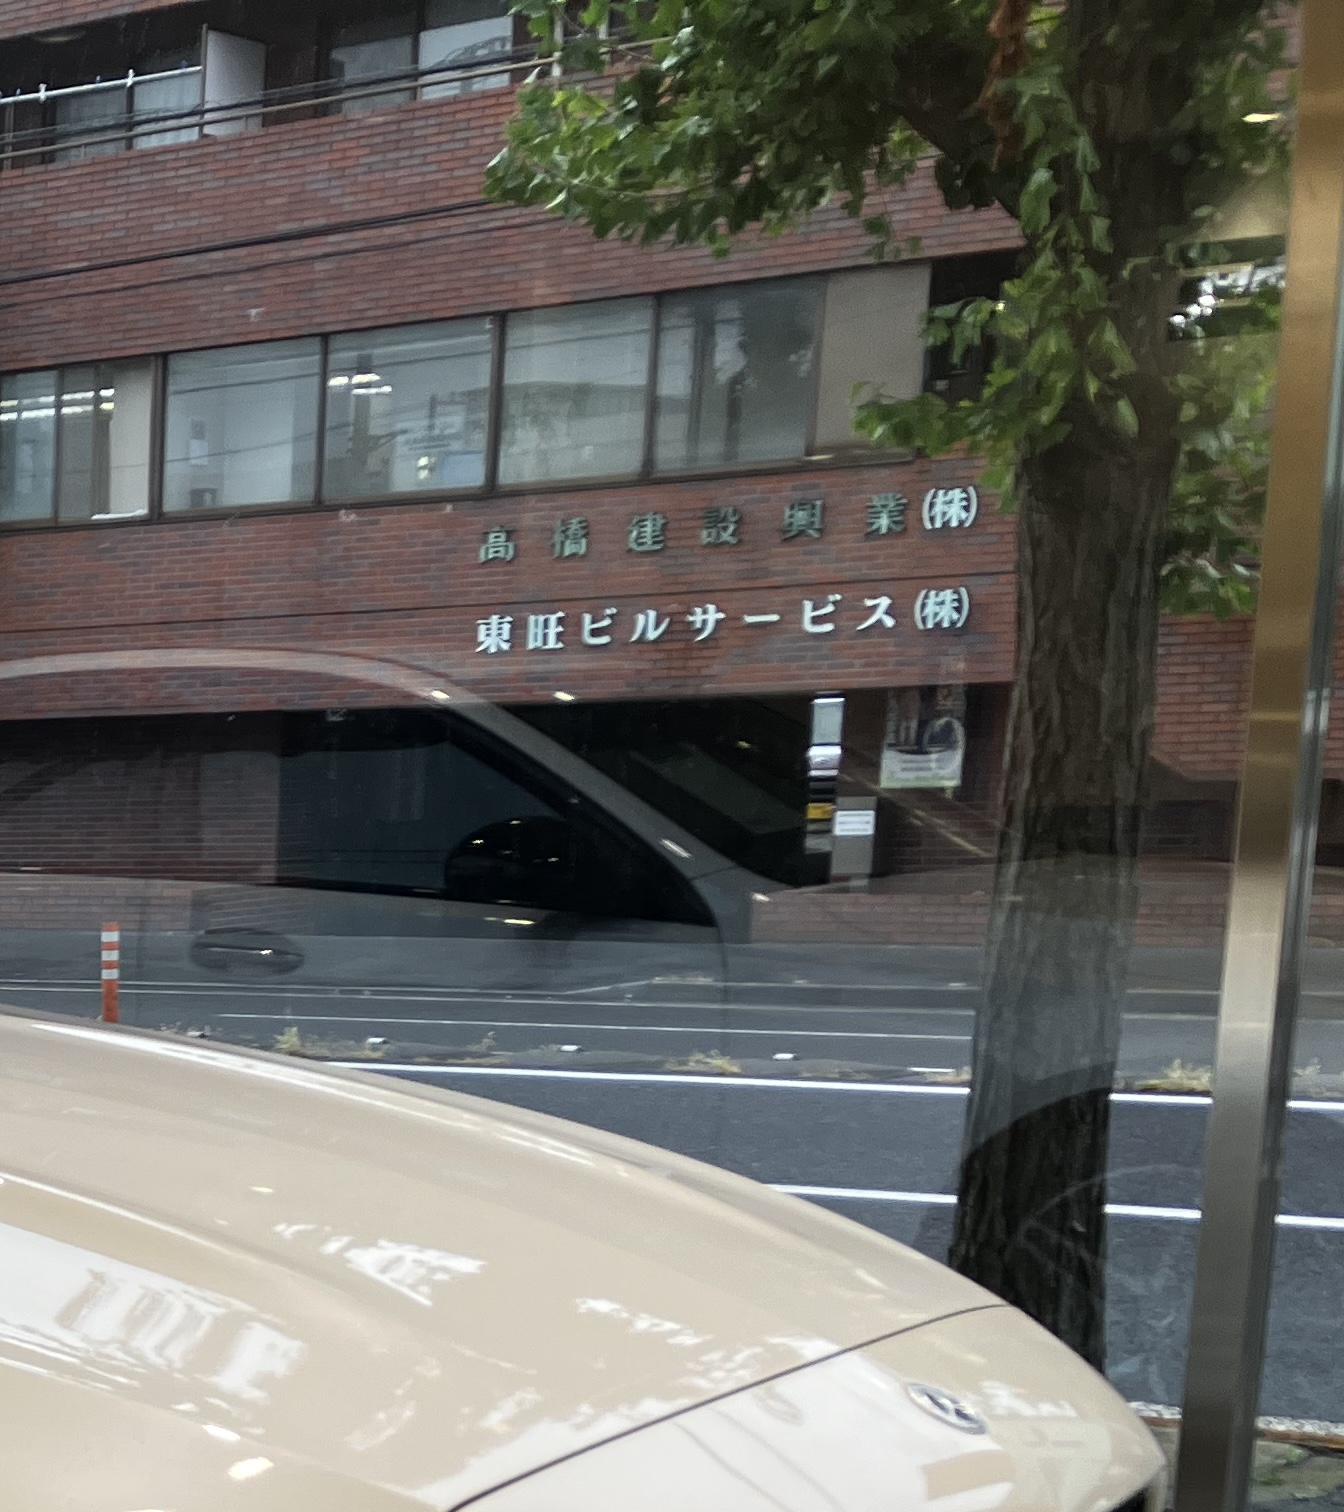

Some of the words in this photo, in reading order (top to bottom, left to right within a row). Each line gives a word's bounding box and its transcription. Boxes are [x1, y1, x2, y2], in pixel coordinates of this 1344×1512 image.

[474, 586, 971, 655] 東旺ビルサービス(株)
